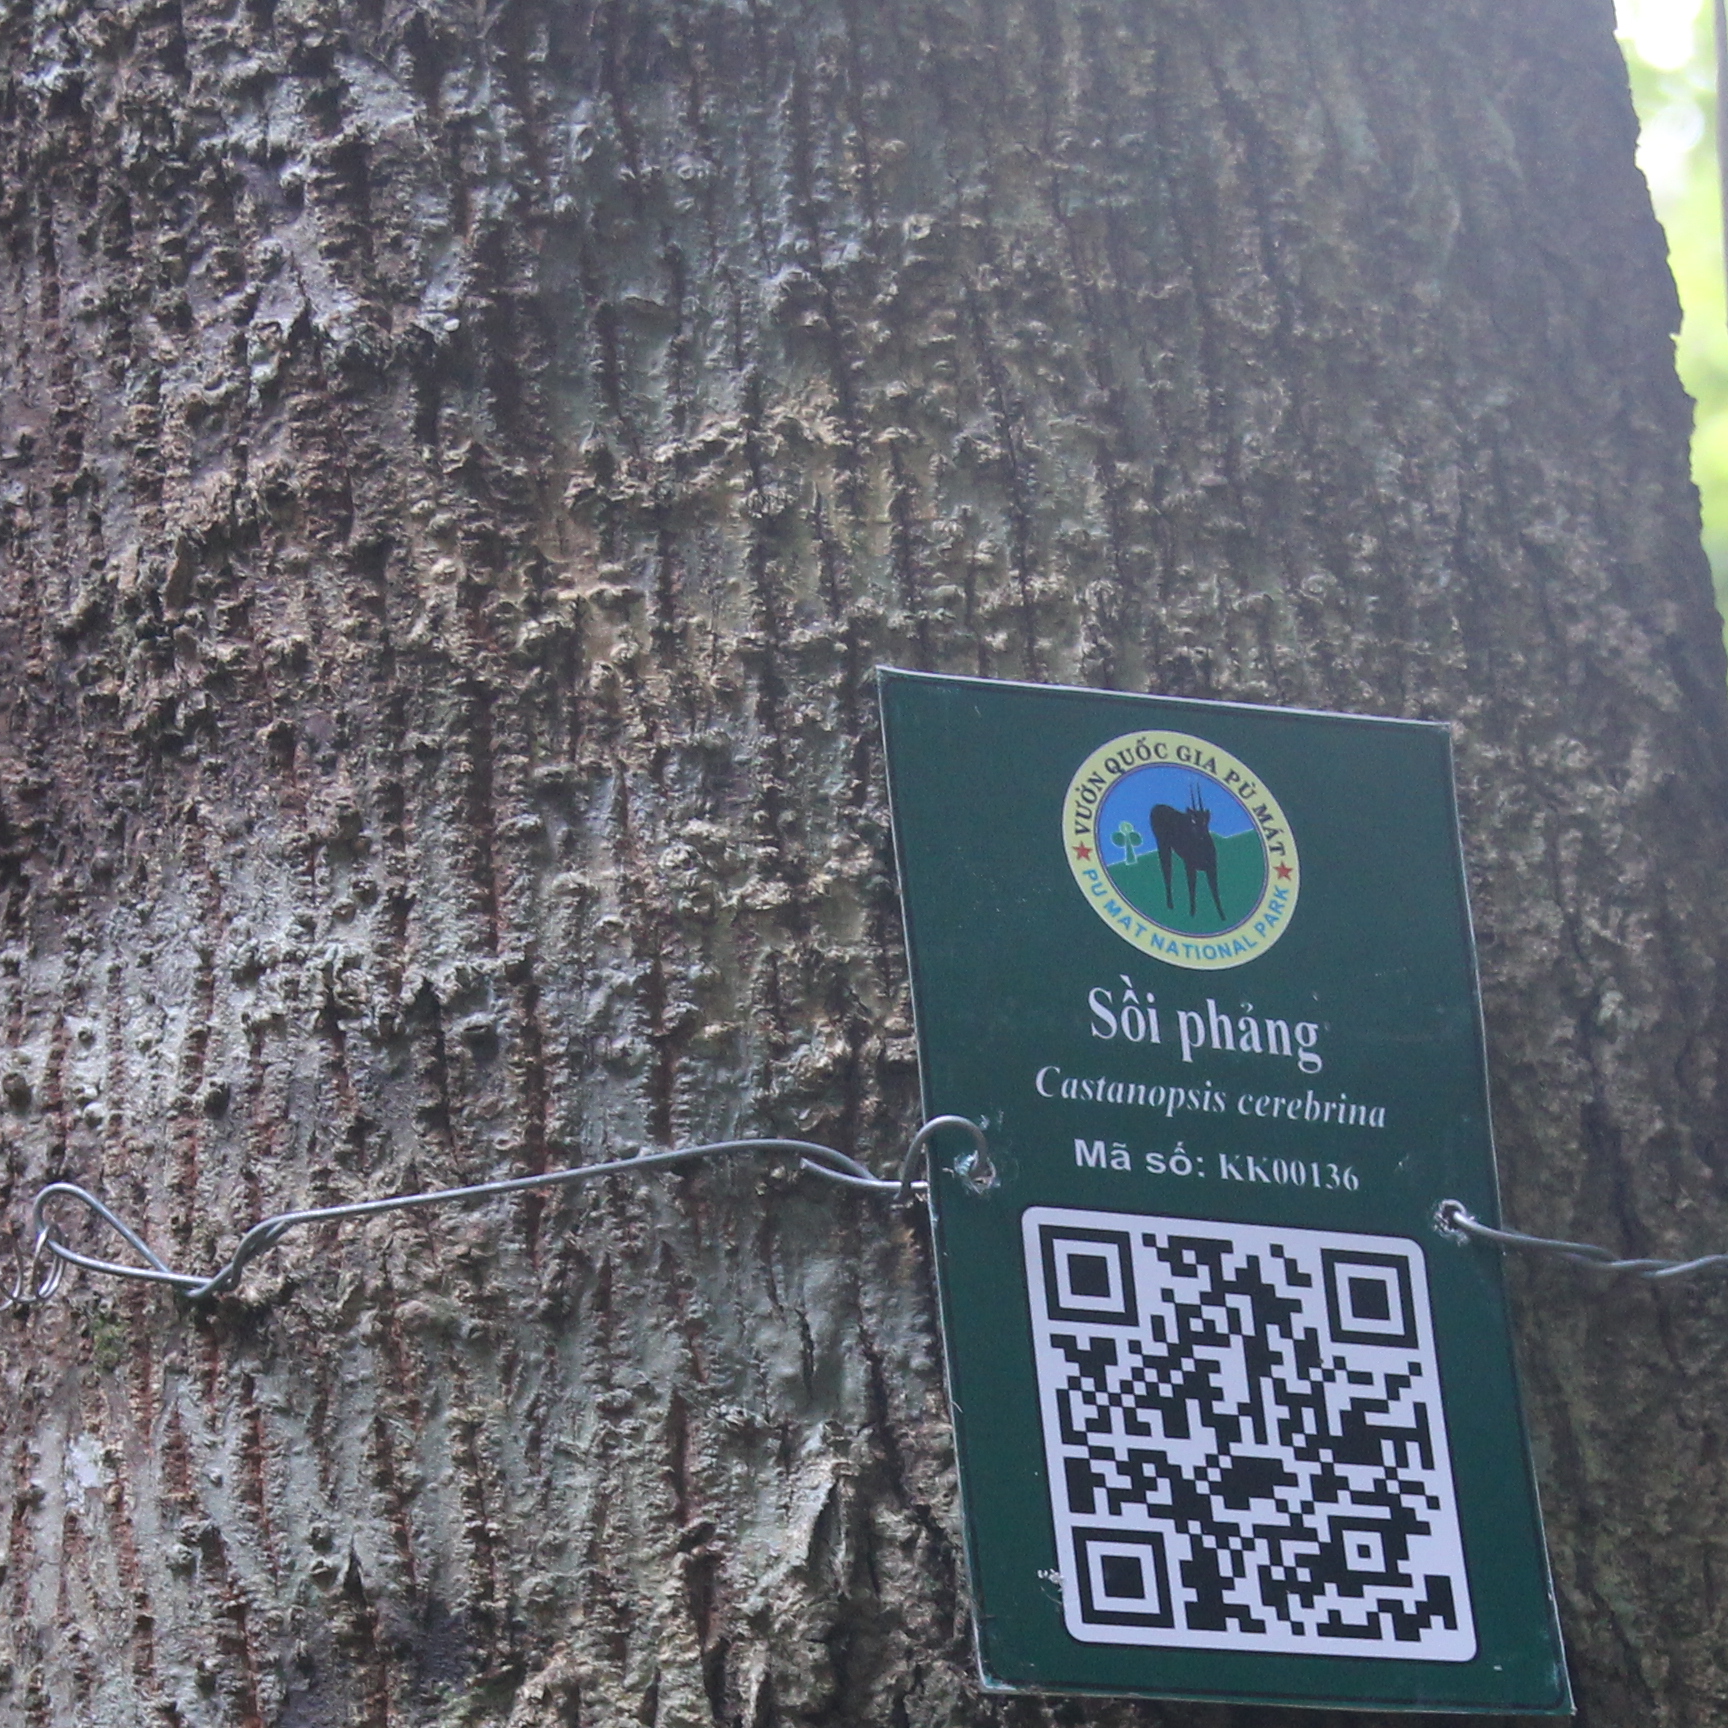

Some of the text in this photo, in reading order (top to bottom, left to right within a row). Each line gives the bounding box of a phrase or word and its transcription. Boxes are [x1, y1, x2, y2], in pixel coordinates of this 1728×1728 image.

[1075, 737, 1286, 857] VƯỜN QUỐC GIA PÙ MÁT
[1082, 869, 1290, 961] PU MAT NATIONAL PARK
[1088, 974, 1322, 1074] Sồi phảng
[1035, 1065, 1387, 1129] Castanopsis cerebrina
[1074, 1138, 1360, 1191] Mã số: KK00136
